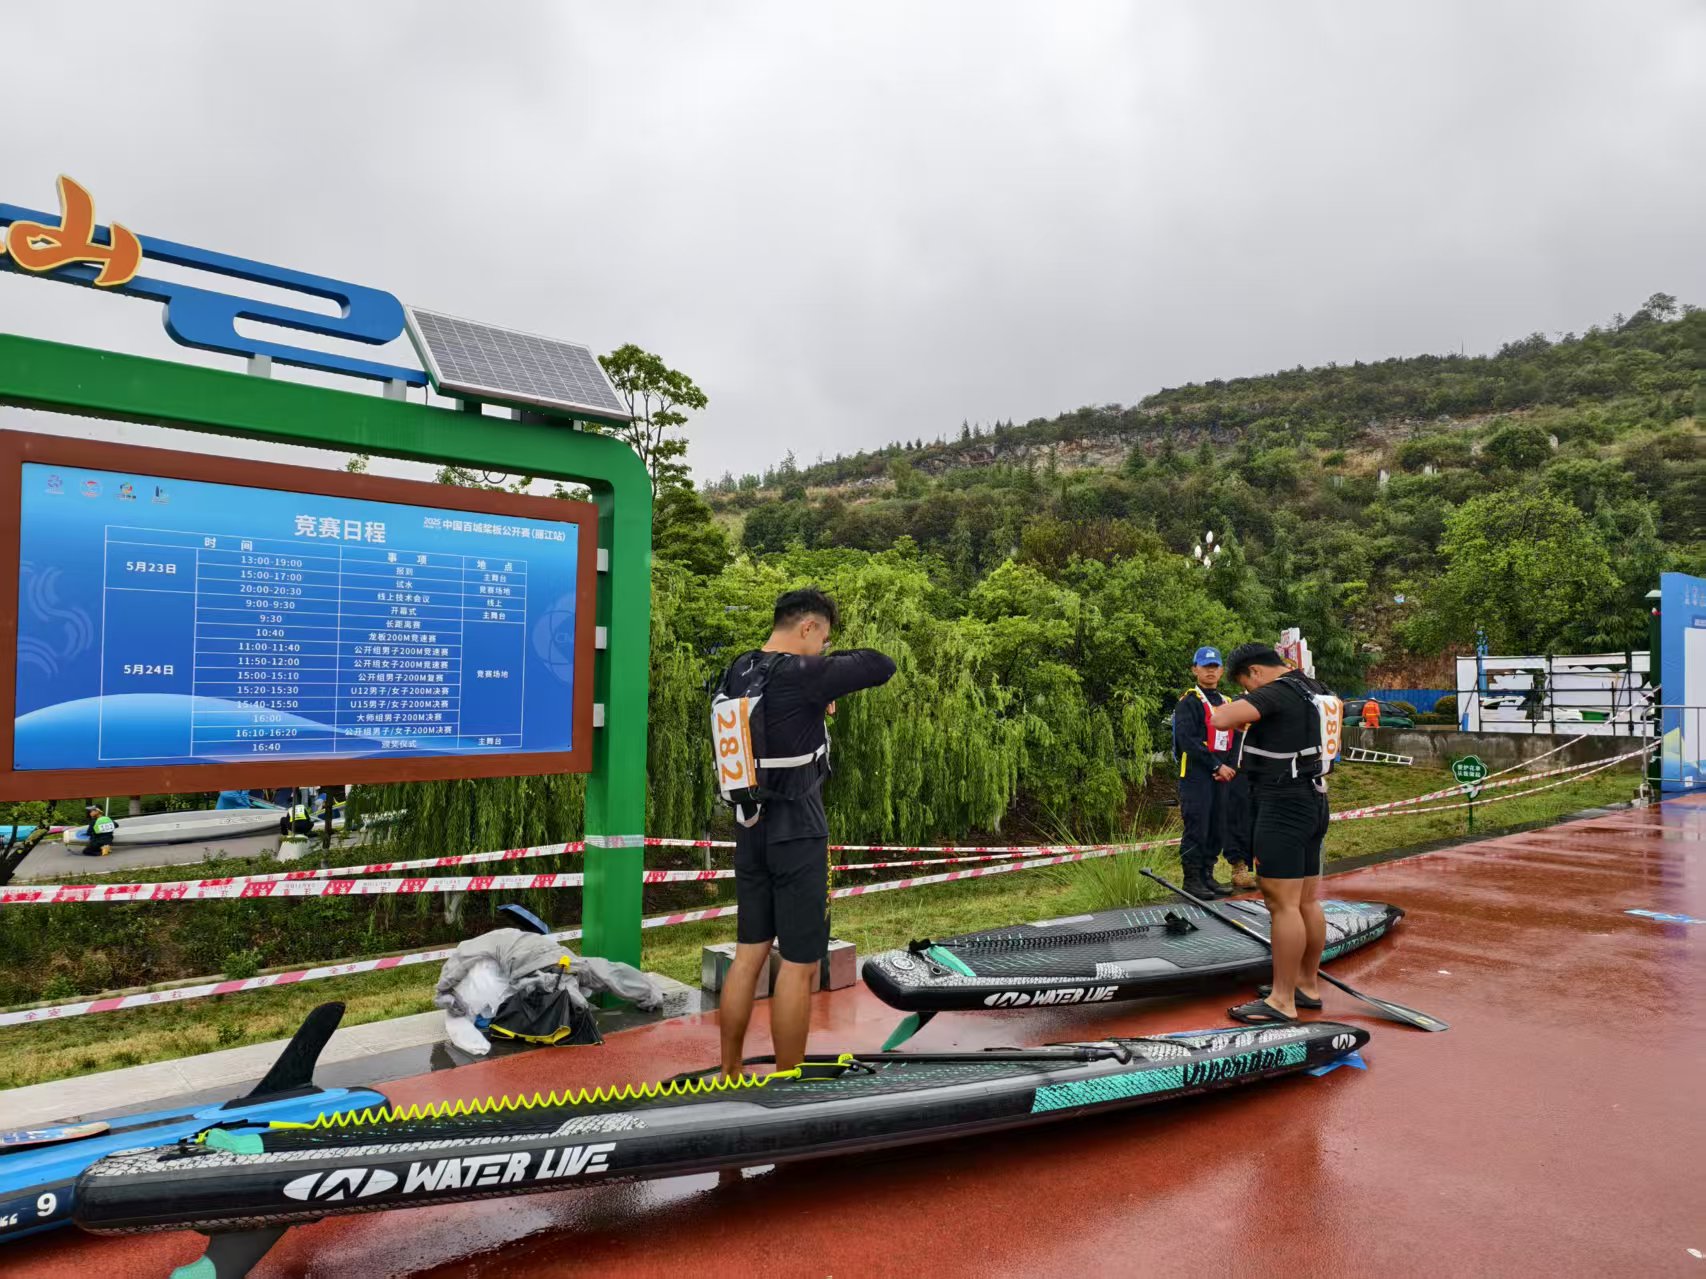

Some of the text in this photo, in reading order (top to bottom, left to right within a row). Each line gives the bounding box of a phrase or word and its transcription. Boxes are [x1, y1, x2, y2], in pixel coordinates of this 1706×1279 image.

[294, 513, 387, 545] 竞赛日程
[126, 560, 177, 574] 5月23日
[240, 555, 303, 568] 13:00-19:00
[240, 570, 303, 582] 15:00-17:00
[239, 584, 302, 597] 20:00-20:30
[245, 599, 296, 611] 9:00-9:30
[259, 613, 283, 624] 9:30
[255, 627, 285, 639] 10:40
[238, 642, 301, 653] 11:00-11:40
[237, 655, 300, 667] 11:50-12:00
[123, 664, 174, 676] 5月24日
[237, 670, 300, 682] 15:00-15:10
[237, 685, 299, 696] 15:20-15:30
[237, 699, 298, 710] 15:40-15:50
[253, 713, 282, 724] 16:00
[235, 727, 298, 739] 16:10-16:20
[1323, 700, 1338, 755] 280
[252, 742, 281, 753] 16:40
[717, 709, 744, 784] 282
[1032, 985, 1120, 1006] WATER LIVE
[402, 1141, 618, 1195] WATER LIVE
[36, 1192, 57, 1217] 9
